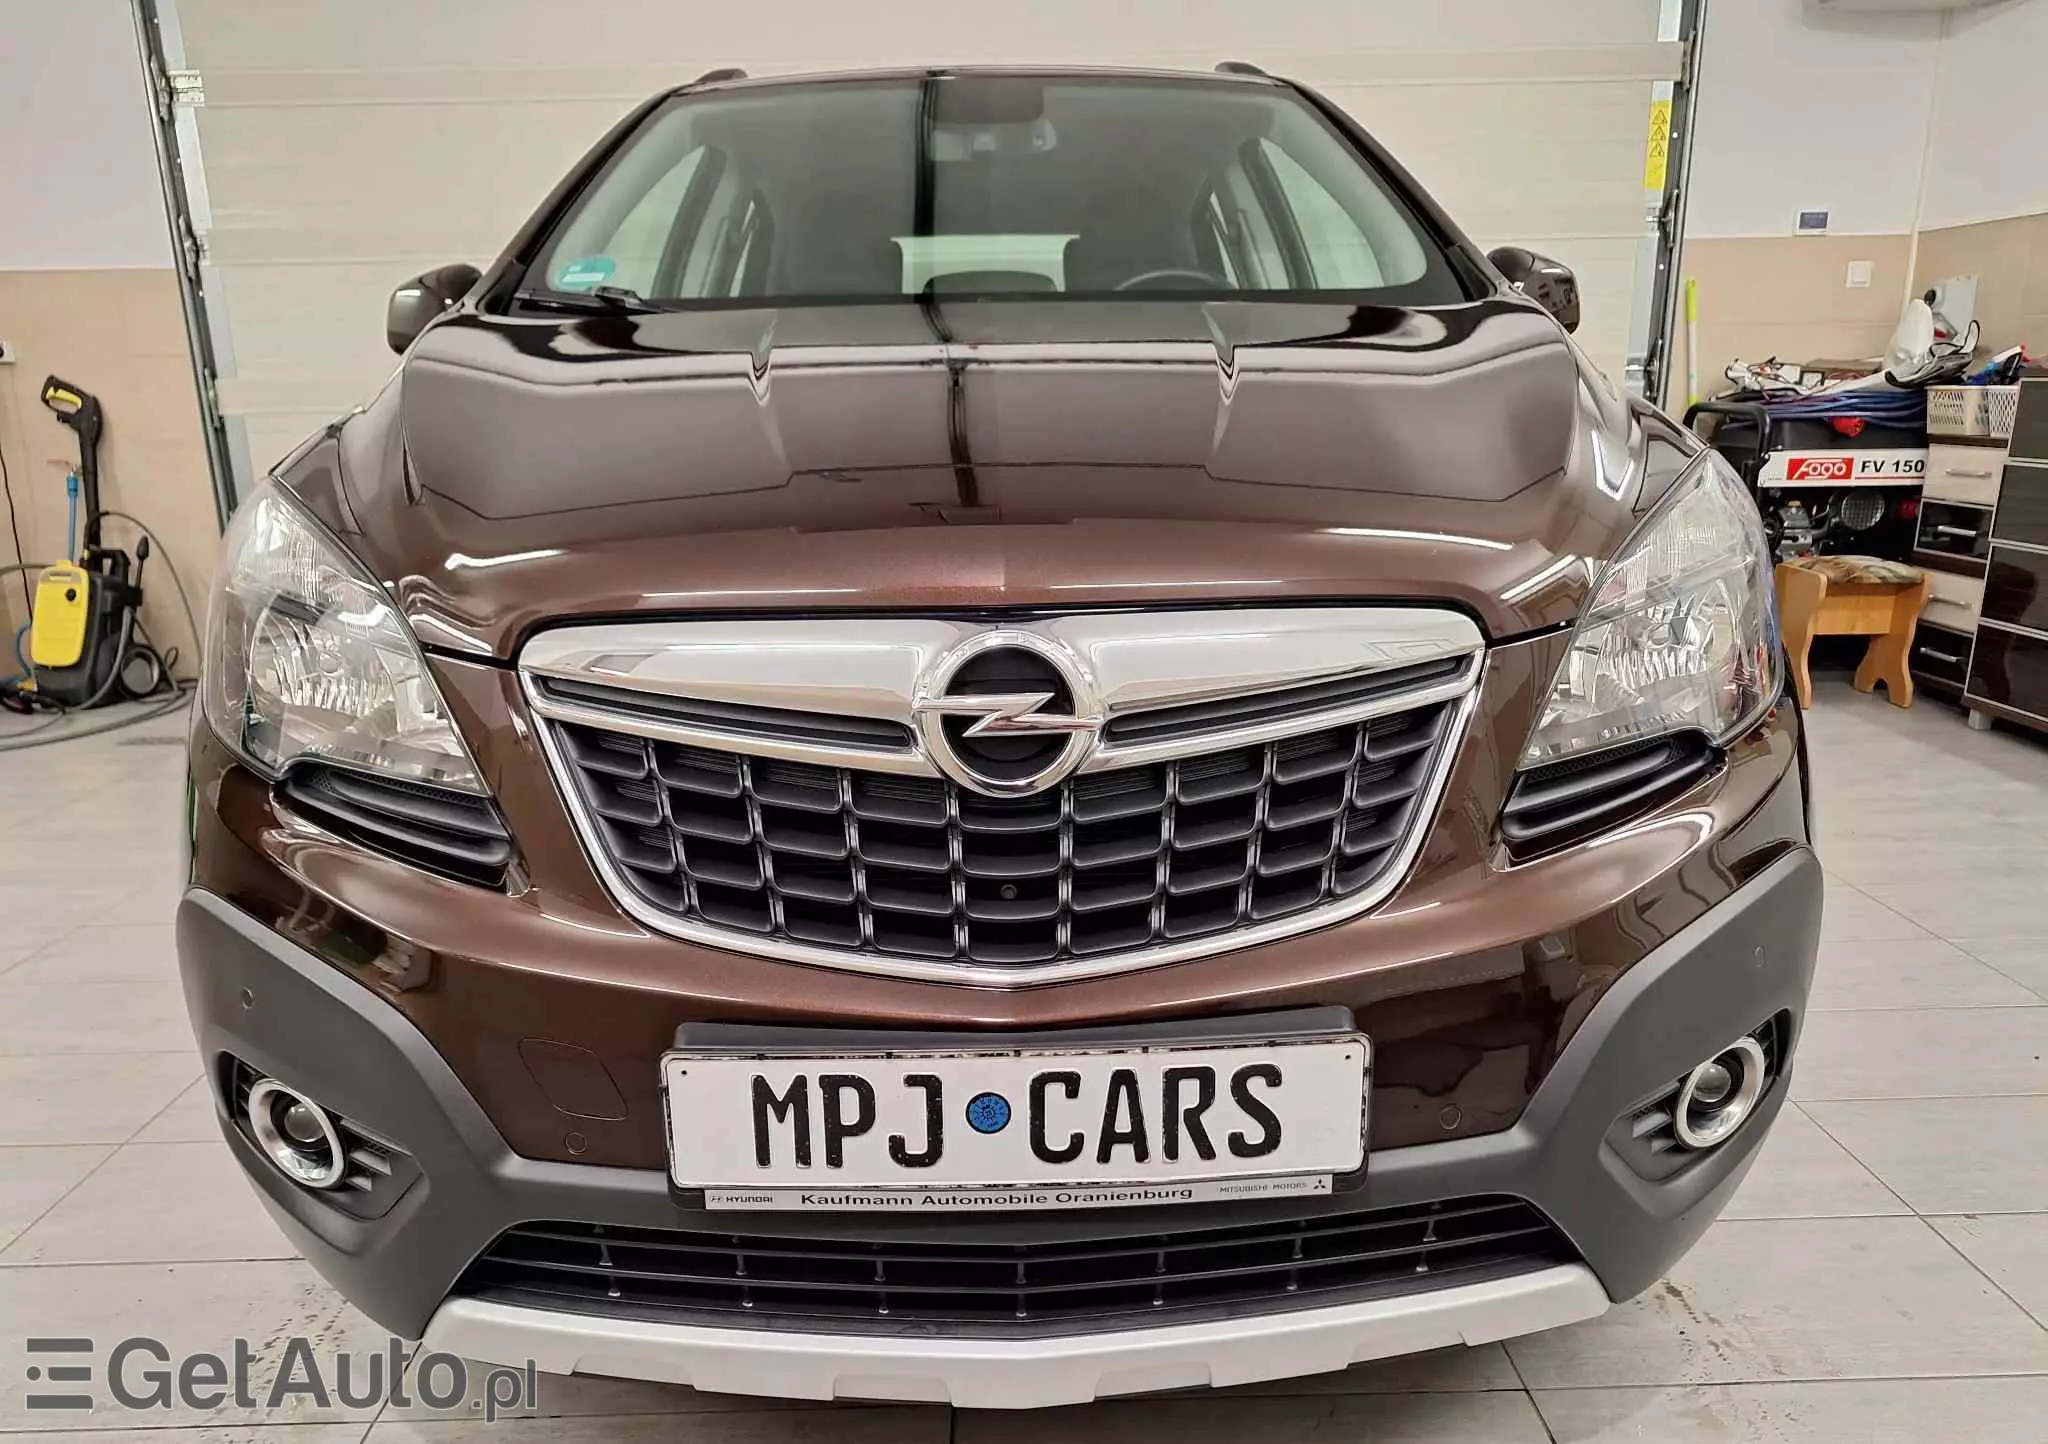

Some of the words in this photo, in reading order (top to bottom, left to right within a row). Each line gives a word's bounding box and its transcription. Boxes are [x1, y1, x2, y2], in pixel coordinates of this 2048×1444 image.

[1861, 460, 1884, 473] FV
[751, 1073, 944, 1168] MPJ
[1028, 1063, 1283, 1163] CARS
[1272, 1182, 1307, 1190] MOTORS
[801, 1194, 913, 1205] Kaufmann
[922, 1193, 1048, 1205] Automobile
[1055, 1189, 1193, 1203] Oranienburg
